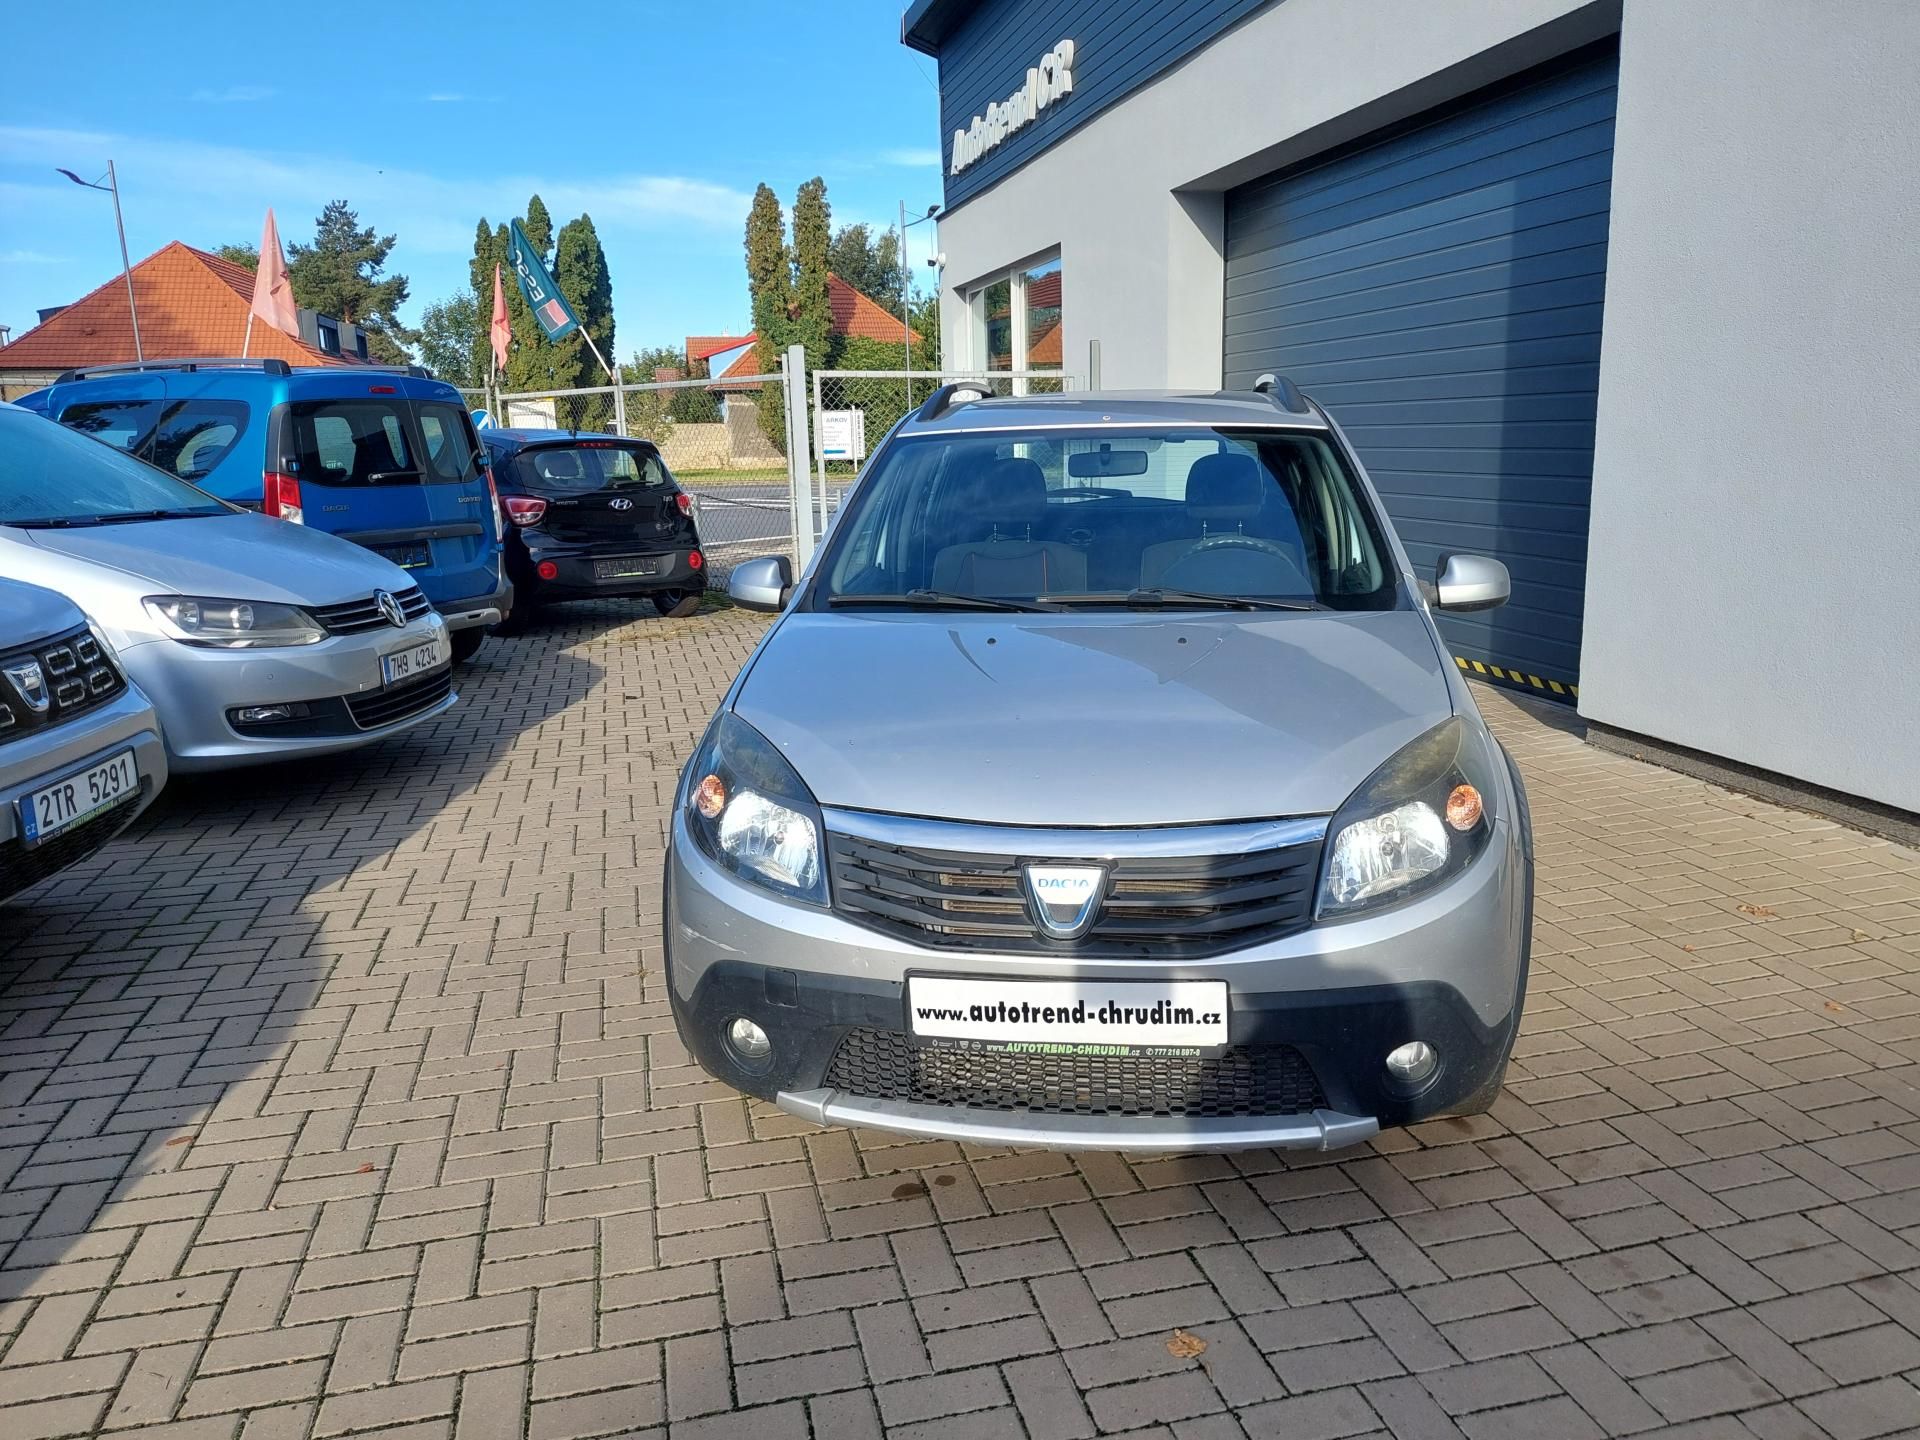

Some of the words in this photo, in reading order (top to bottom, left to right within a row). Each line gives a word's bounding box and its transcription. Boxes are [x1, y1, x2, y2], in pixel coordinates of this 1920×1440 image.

[391, 654, 409, 678] 7H9
[415, 644, 437, 668] 4234
[40, 784, 78, 828] 2TR
[88, 758, 129, 803] 5291
[25, 822, 37, 836] CZ
[1038, 878, 1089, 888] DACIA
[916, 999, 1222, 1025] www.autotrend-chrudim.cz
[986, 1042, 1141, 1056] www.AUTOTREND-CHRUDIM.cz
[1154, 1048, 1166, 1056] 777
